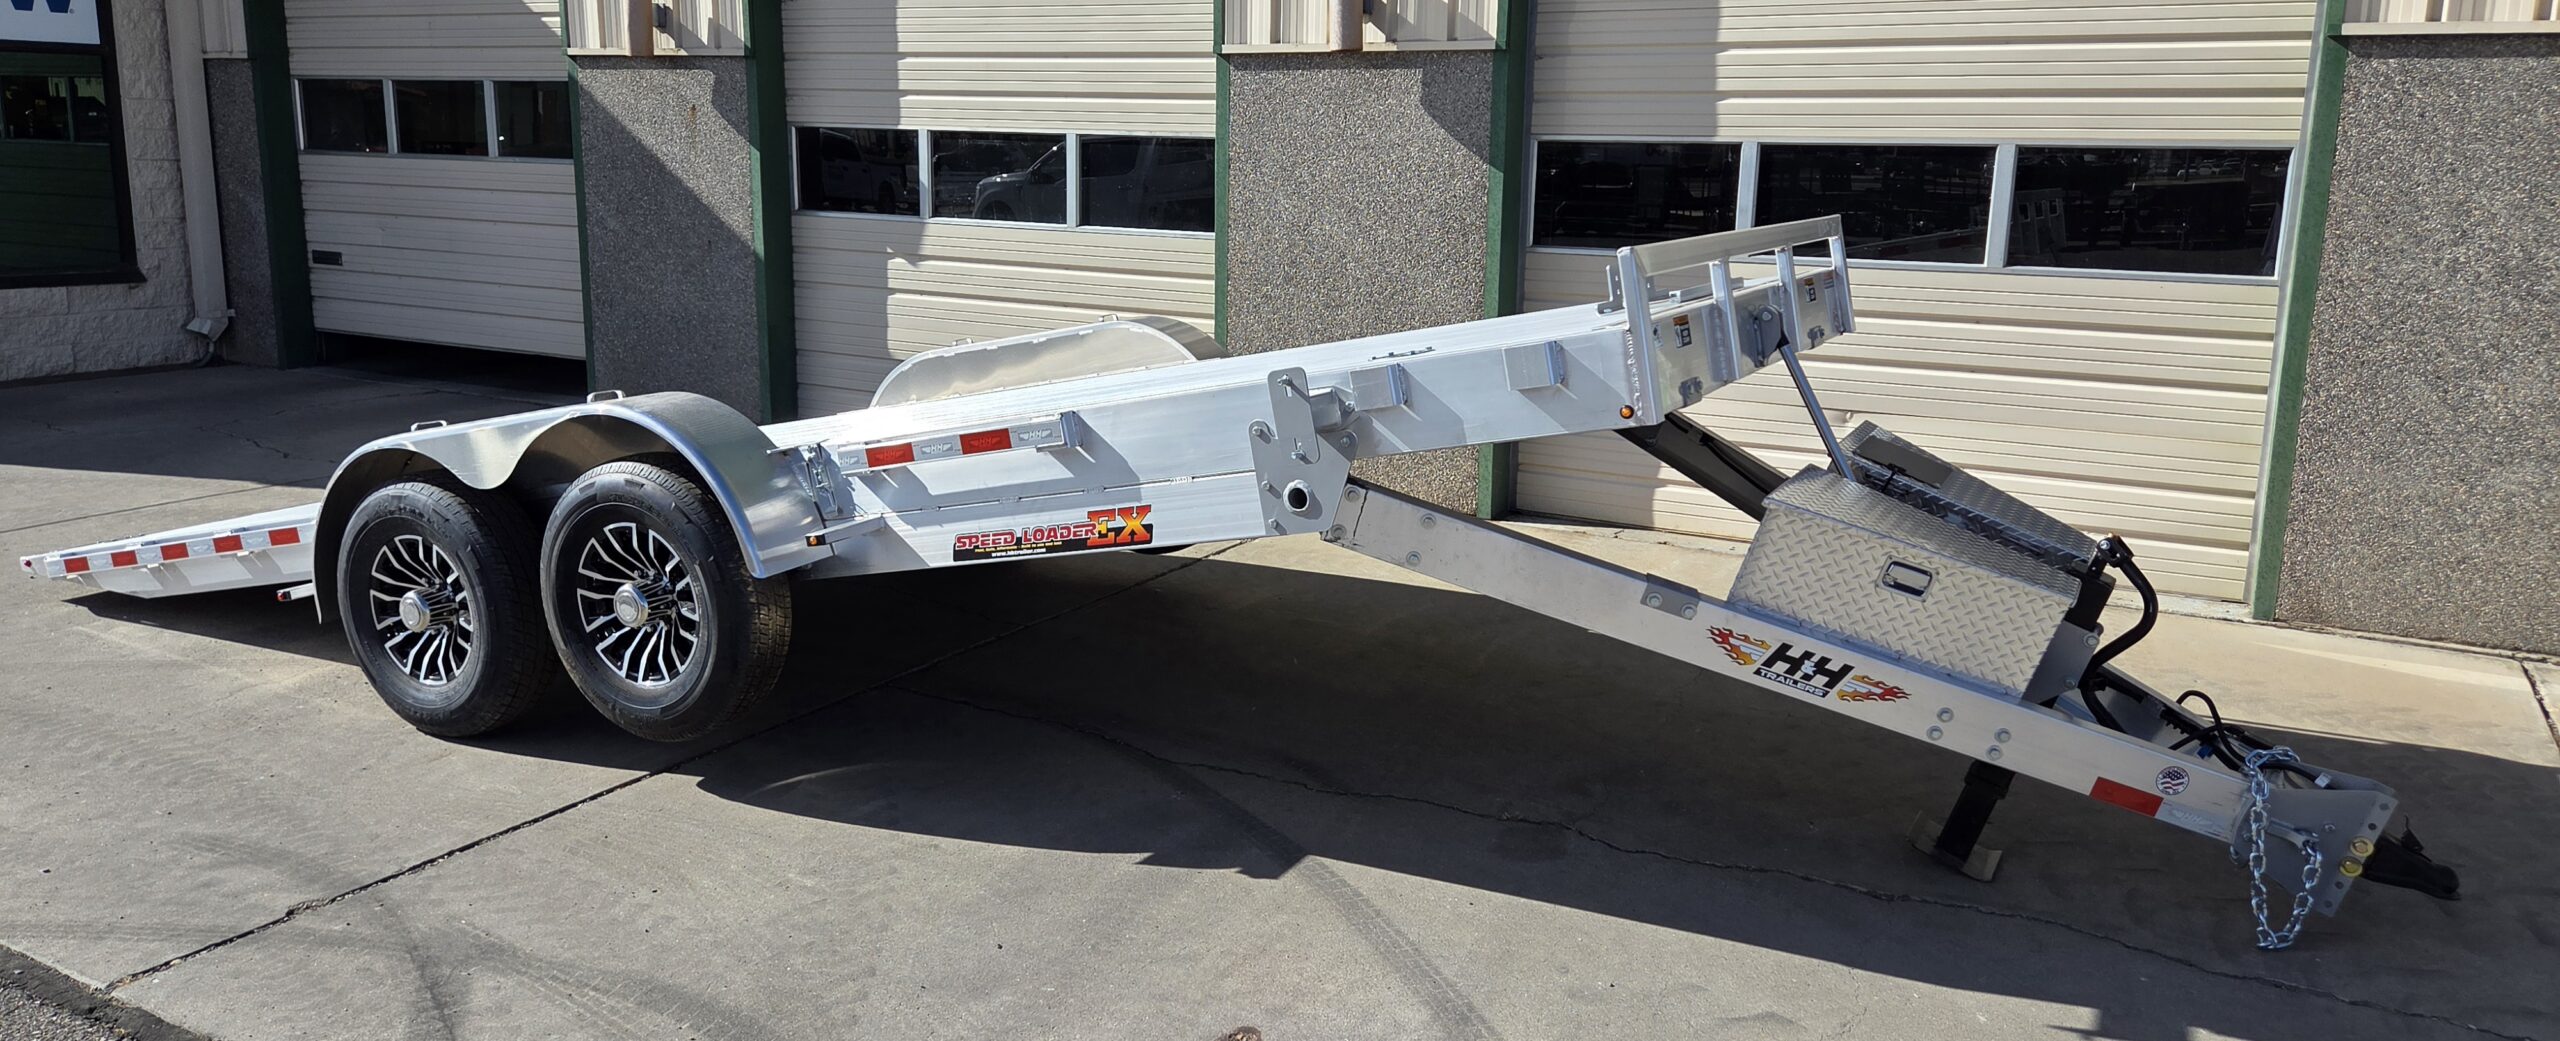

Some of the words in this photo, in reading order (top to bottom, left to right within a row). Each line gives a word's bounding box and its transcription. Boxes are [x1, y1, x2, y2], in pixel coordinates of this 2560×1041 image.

[955, 531, 1016, 550] SPEED
[1022, 522, 1098, 544] LOADER
[1087, 504, 1152, 546] EX
[1758, 669, 1826, 697] TRAILERS
[1760, 642, 1855, 690] H&H
